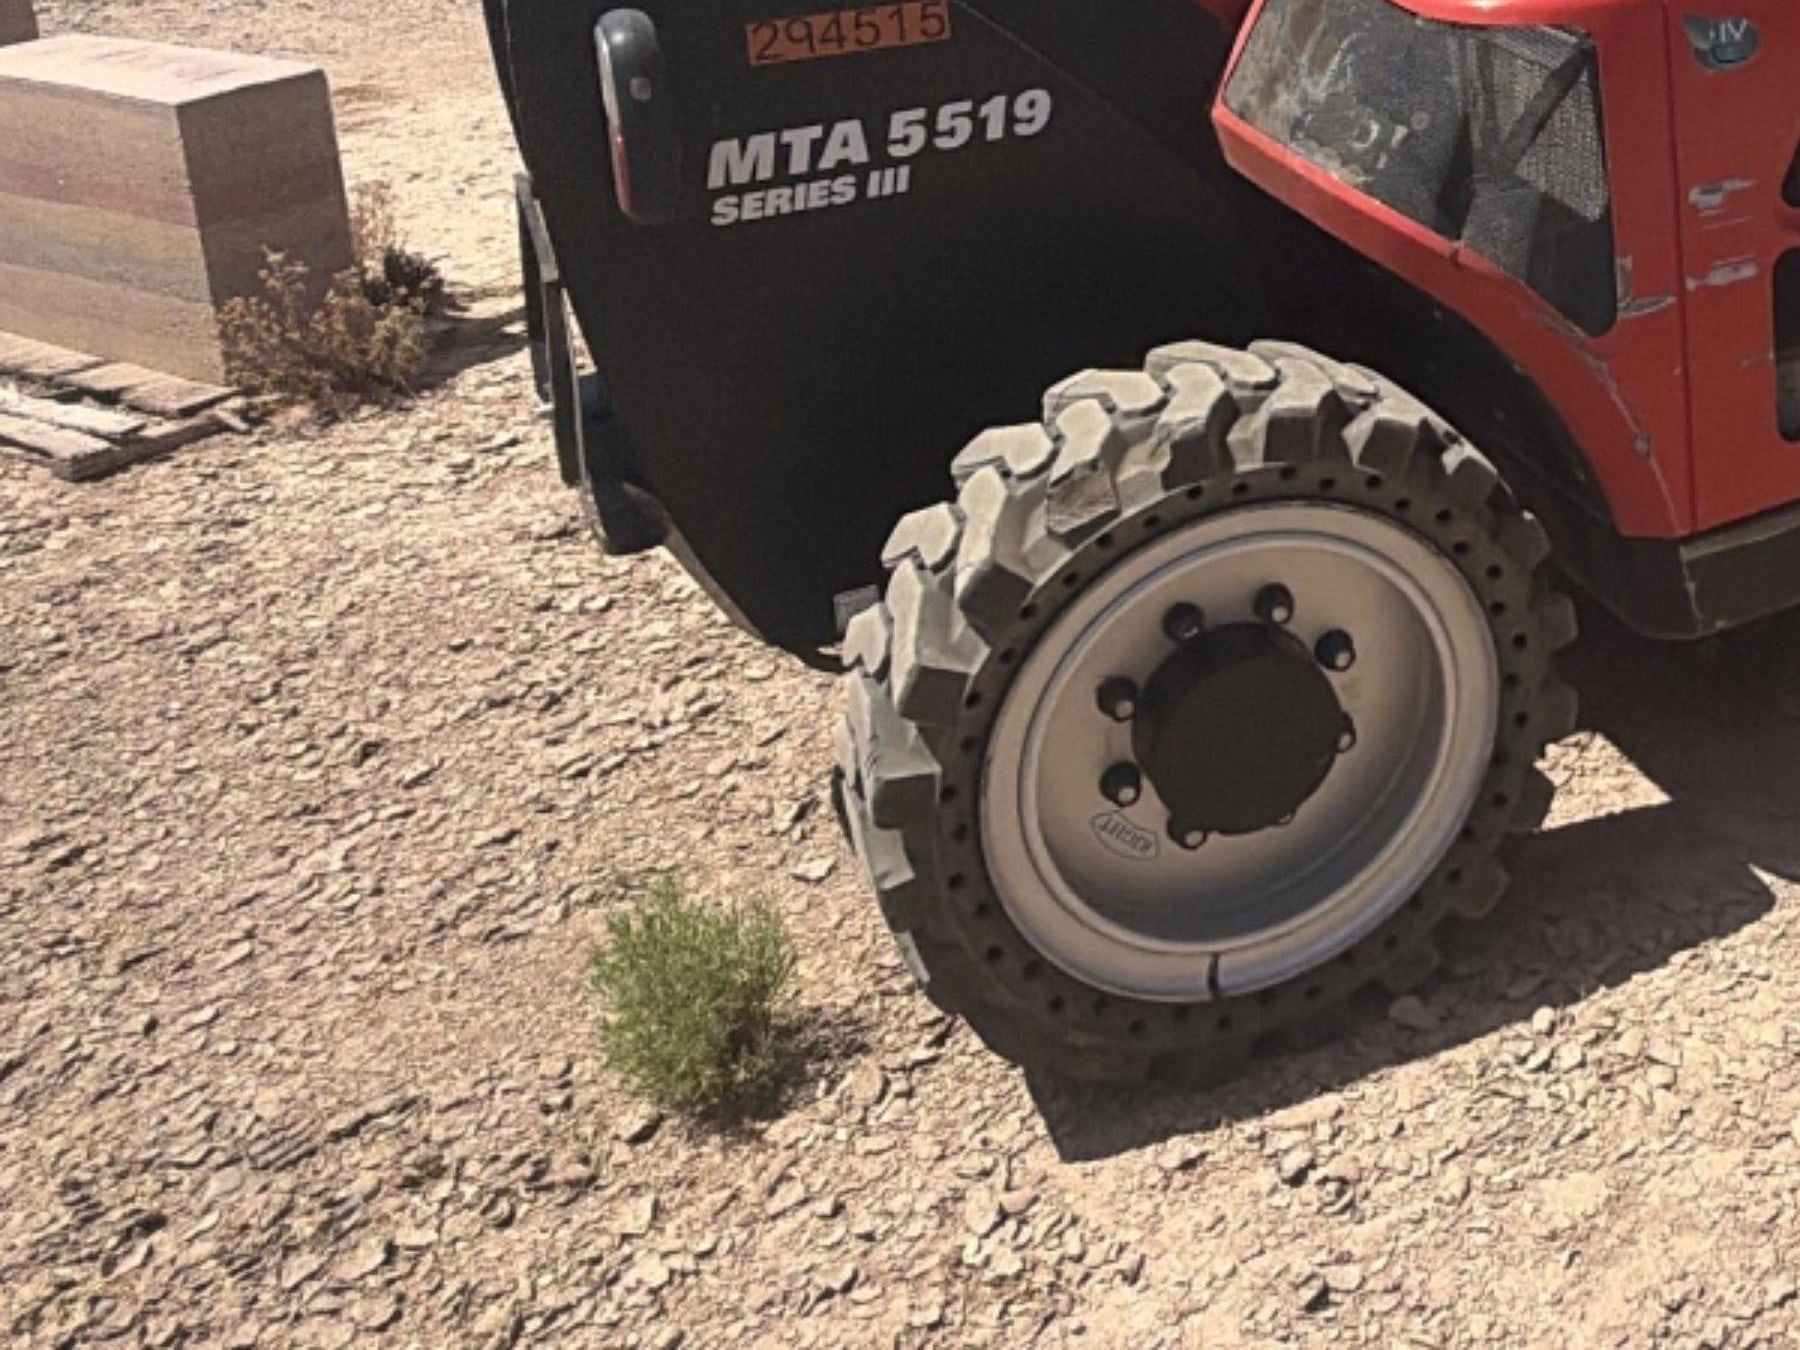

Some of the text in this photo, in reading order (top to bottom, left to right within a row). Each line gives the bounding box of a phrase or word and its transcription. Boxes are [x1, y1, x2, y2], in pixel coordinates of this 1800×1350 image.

[753, 1, 947, 61] 294515
[708, 88, 1052, 188] MTA 5519
[710, 165, 910, 226] SERIES III
